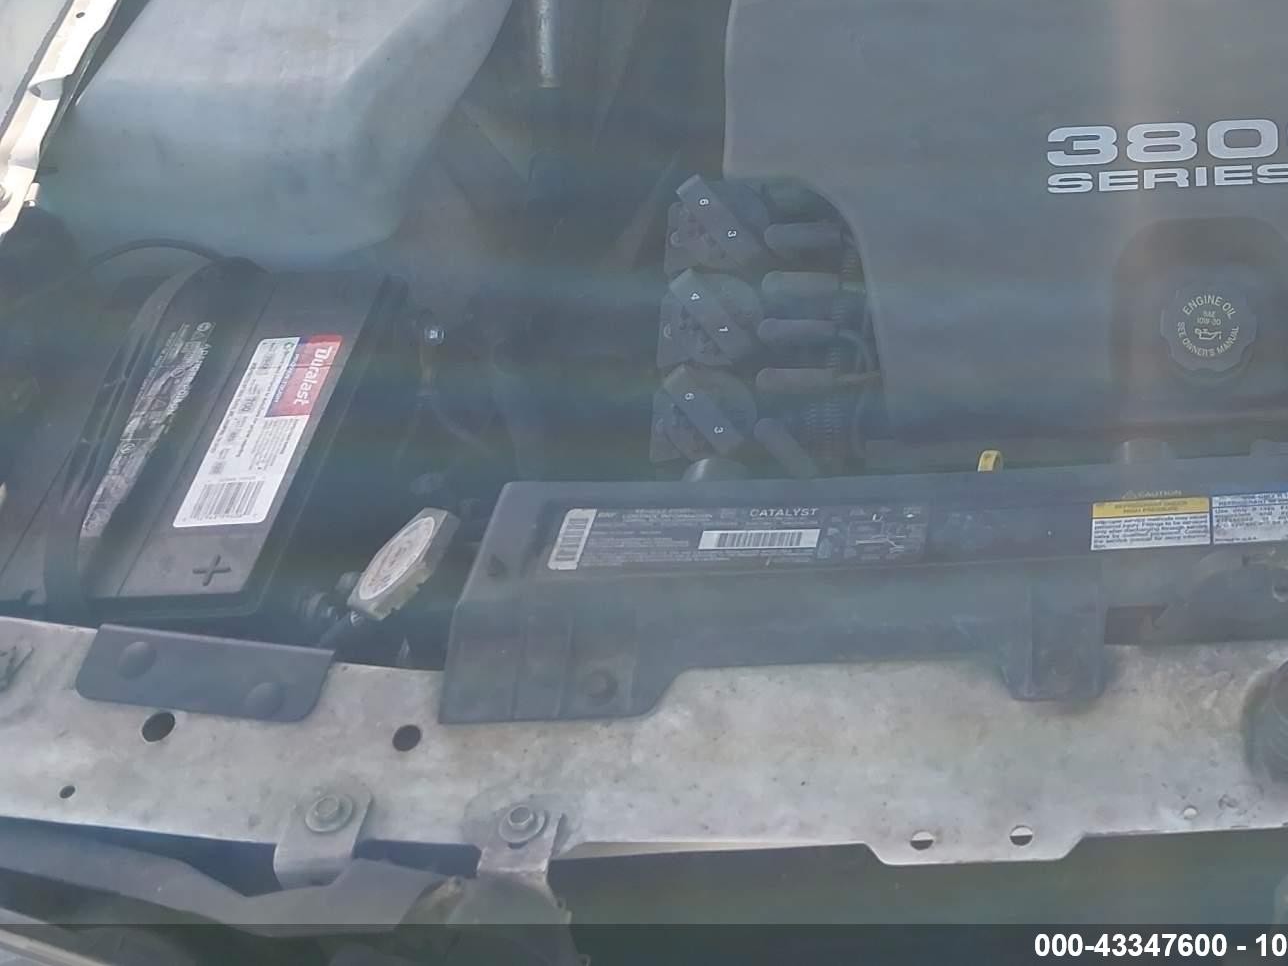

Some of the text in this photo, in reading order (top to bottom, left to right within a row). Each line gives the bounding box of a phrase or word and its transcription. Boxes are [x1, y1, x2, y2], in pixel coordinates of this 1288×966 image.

[727, 229, 737, 238] 3
[690, 292, 700, 301] 4
[1182, 294, 1236, 319] ENGINE OIL
[1216, 326, 1239, 354] MANUAL
[293, 346, 333, 405] Duralast
[750, 507, 819, 517] CATALYST
